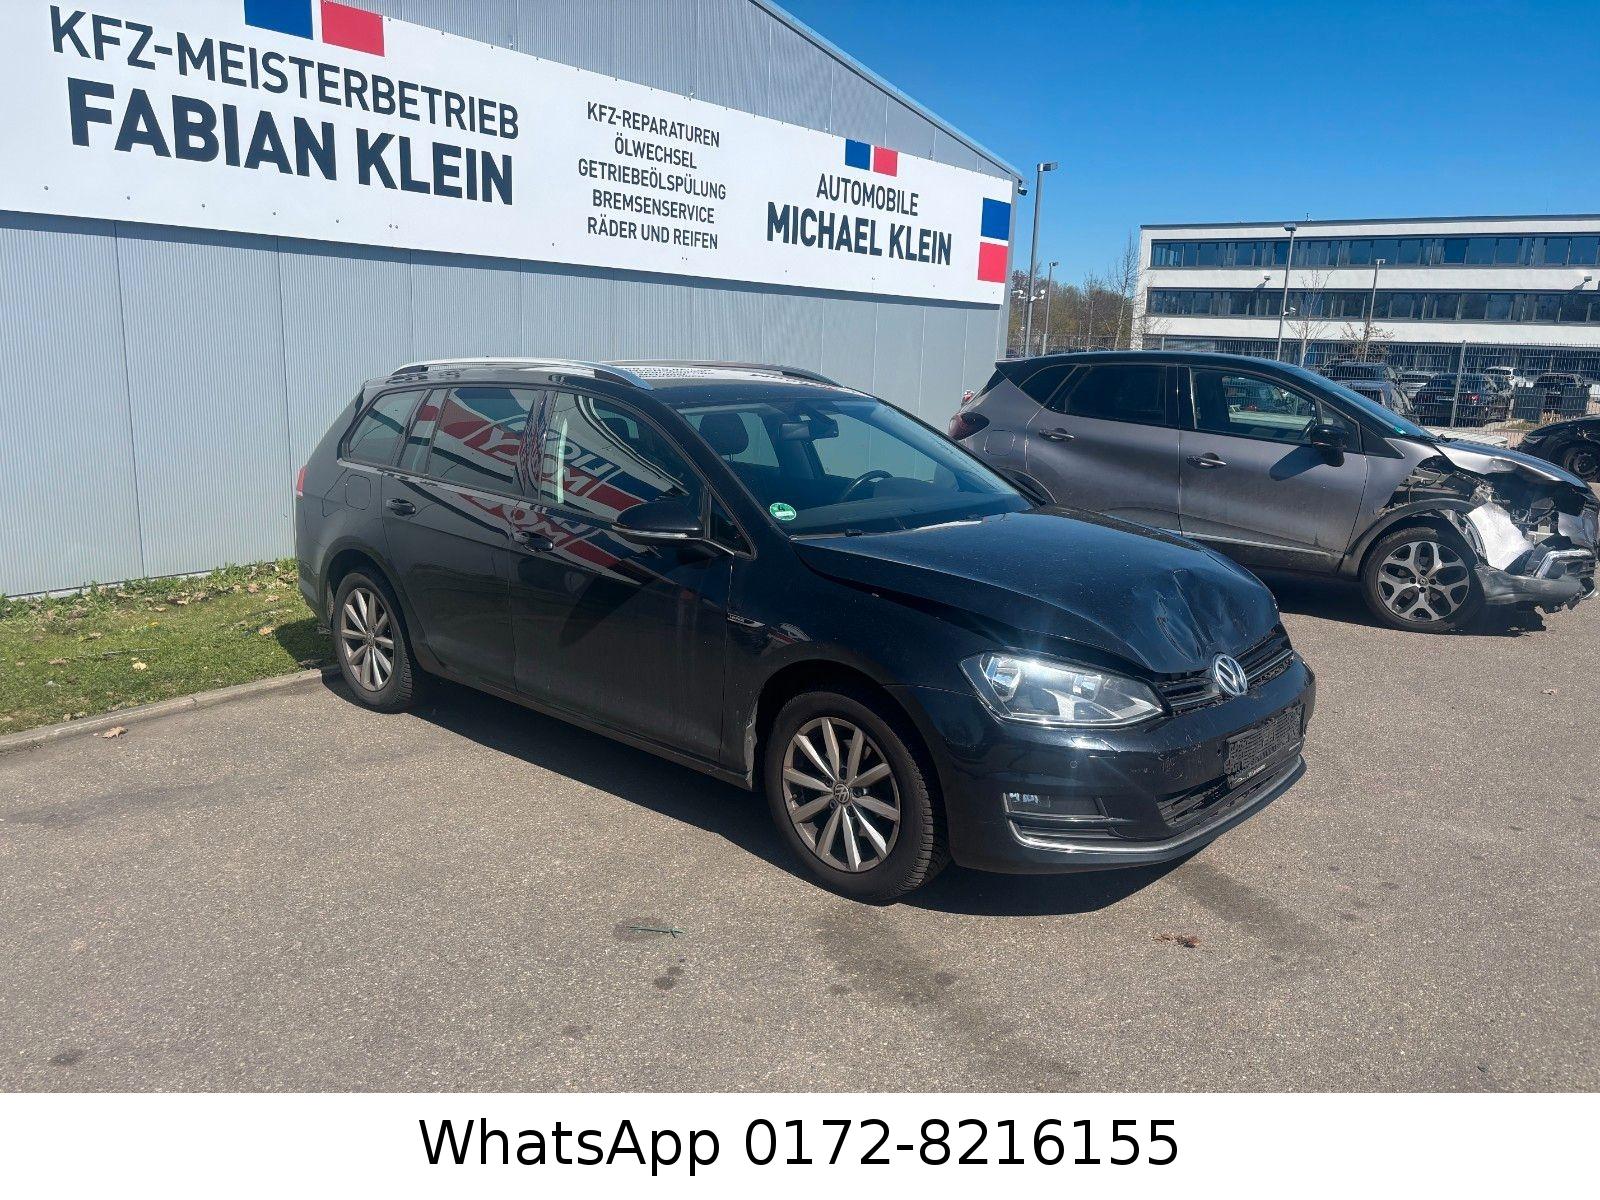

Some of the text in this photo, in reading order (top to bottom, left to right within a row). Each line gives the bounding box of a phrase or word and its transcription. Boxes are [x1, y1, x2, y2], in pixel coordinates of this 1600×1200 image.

[50, 5, 519, 140] KFZ-MEISTERBETRIEB
[67, 76, 513, 206] FABIAN KLEIN
[587, 101, 720, 148] KFZ-REPARATUREN
[614, 132, 699, 170] ÖLWECHSEL
[578, 158, 727, 201] GETRIEBEÖLSPÜLUNG
[816, 173, 919, 217] AUTOMOBILE
[592, 188, 715, 225] BREMSENSERVICE
[587, 214, 718, 250] RÄDER UND REIFEN
[766, 201, 952, 266] MICHAEL KLEIN
